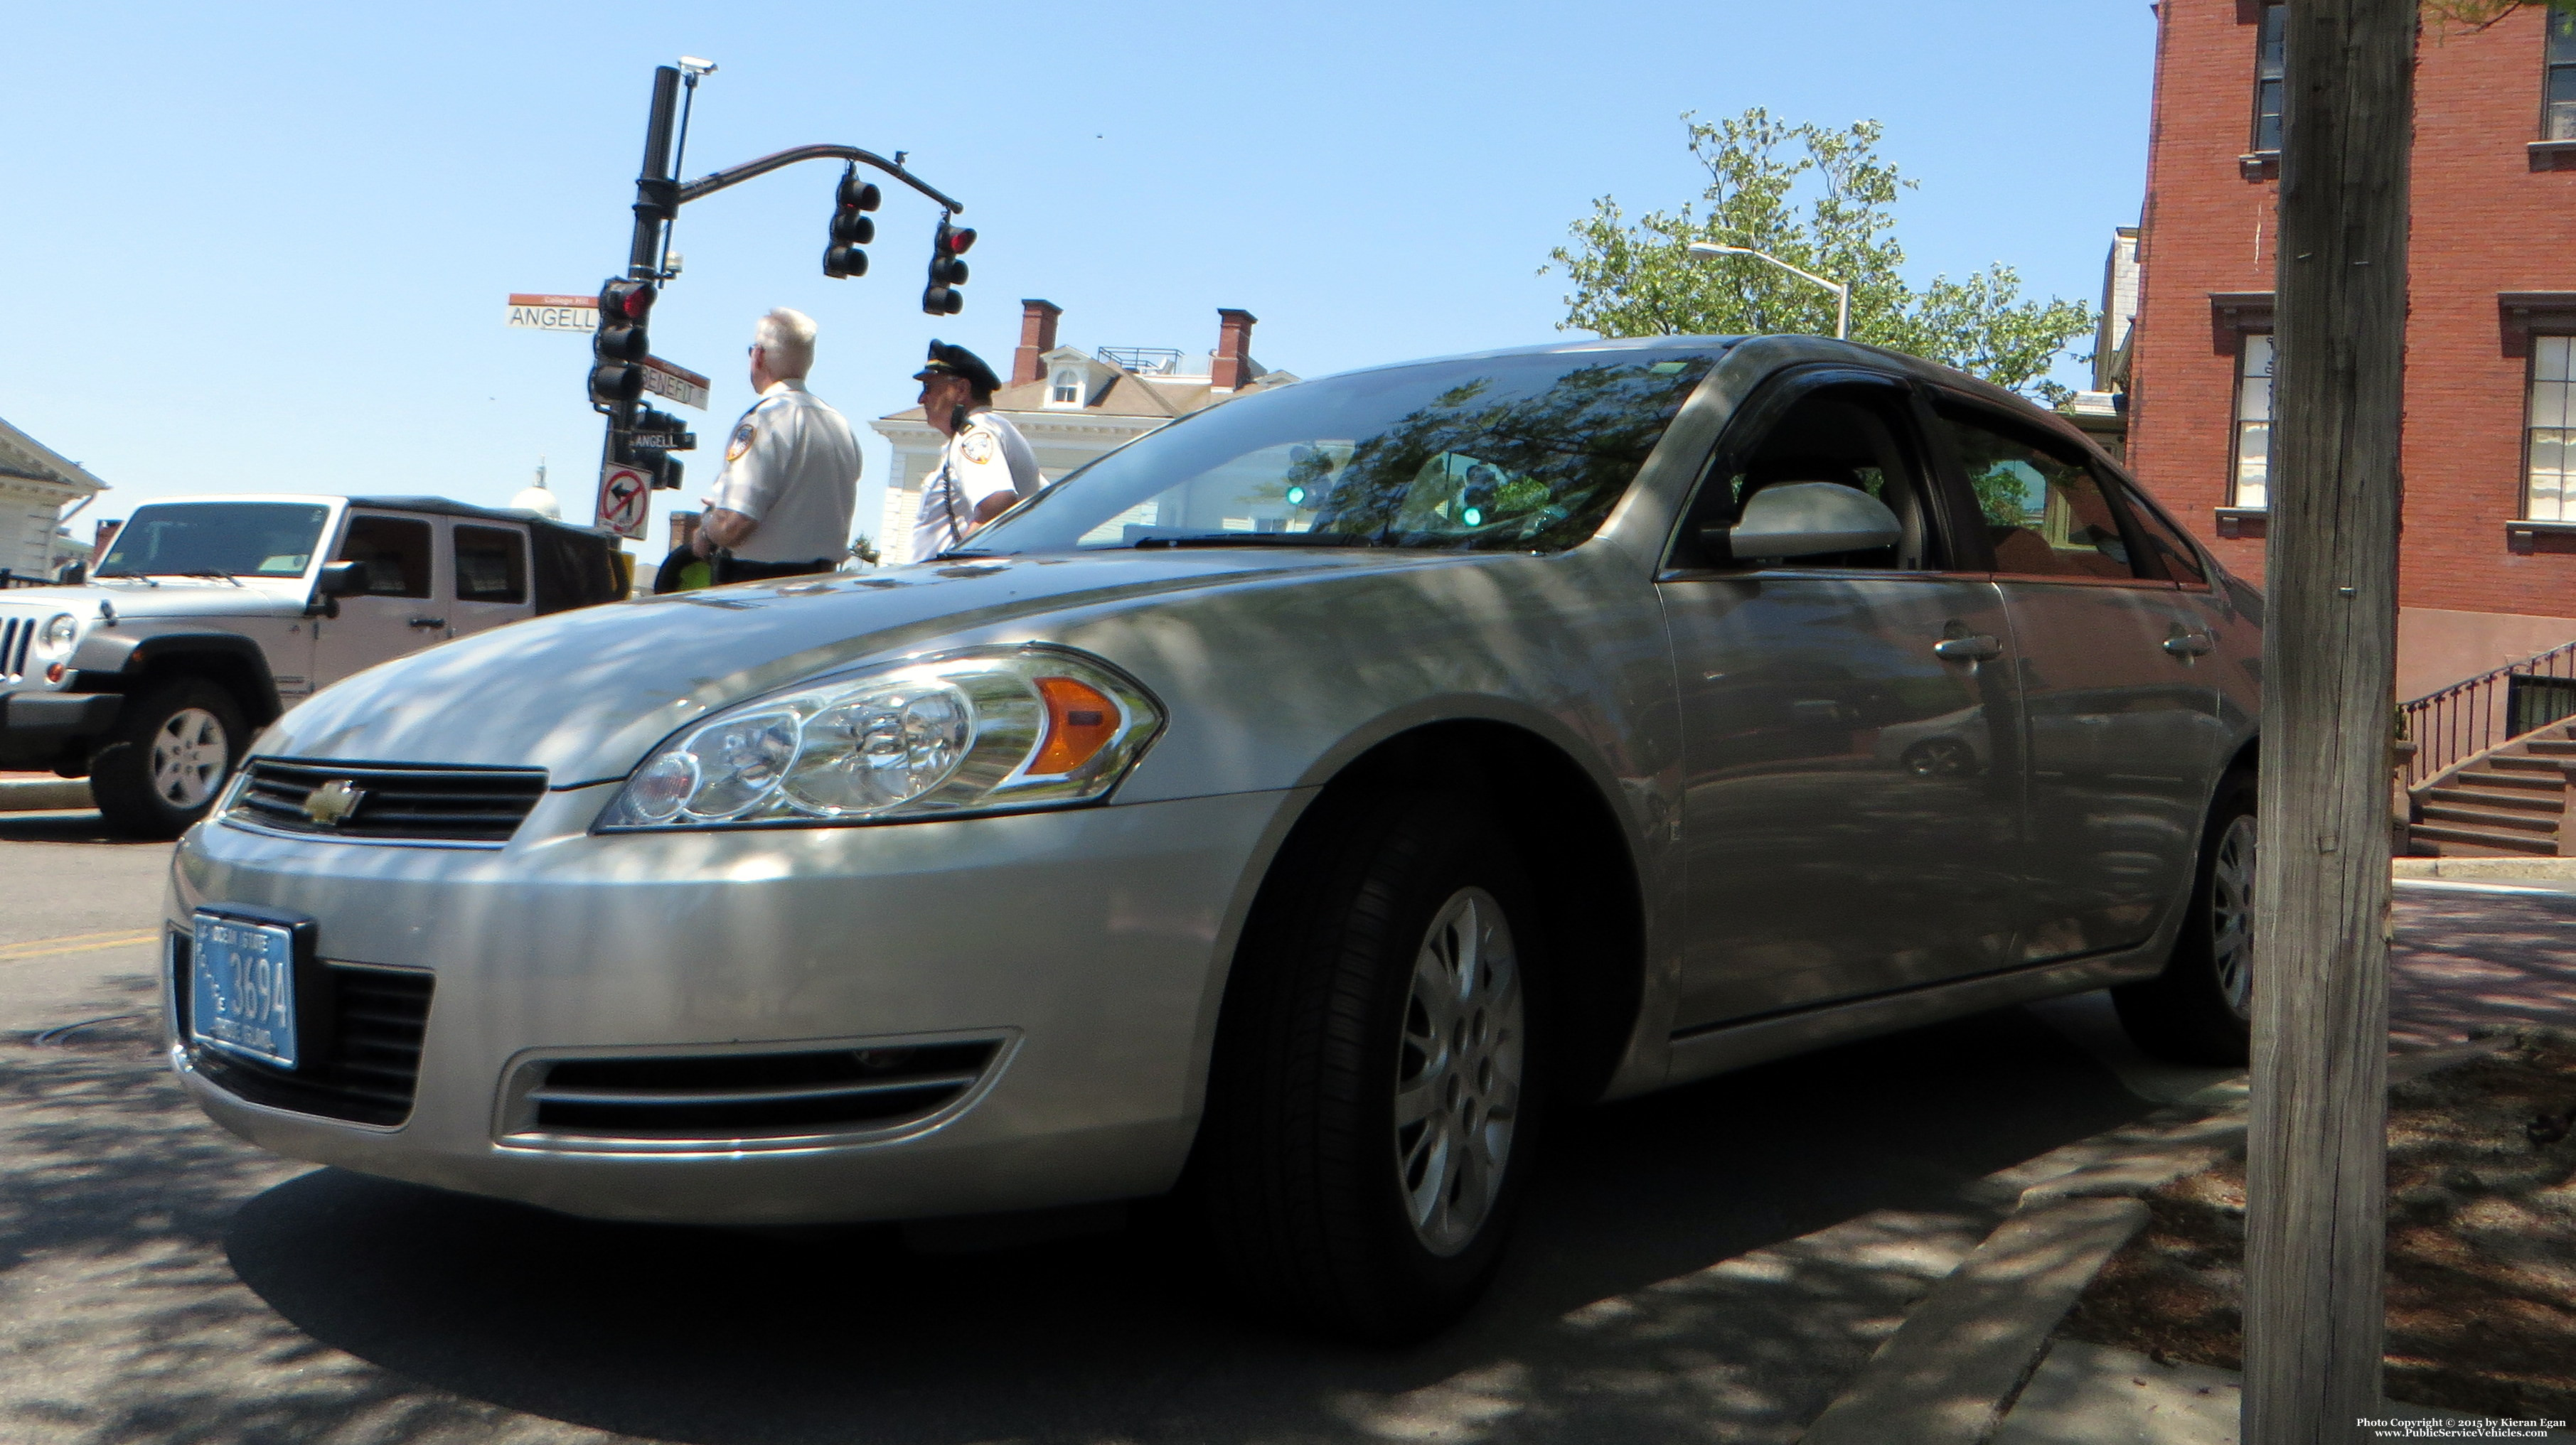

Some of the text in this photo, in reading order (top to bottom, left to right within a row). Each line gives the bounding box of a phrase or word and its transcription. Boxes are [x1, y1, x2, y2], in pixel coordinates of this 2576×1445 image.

[511, 307, 596, 328] ANGELL
[636, 434, 678, 448] ANGELL
[230, 952, 286, 1027] 3694
